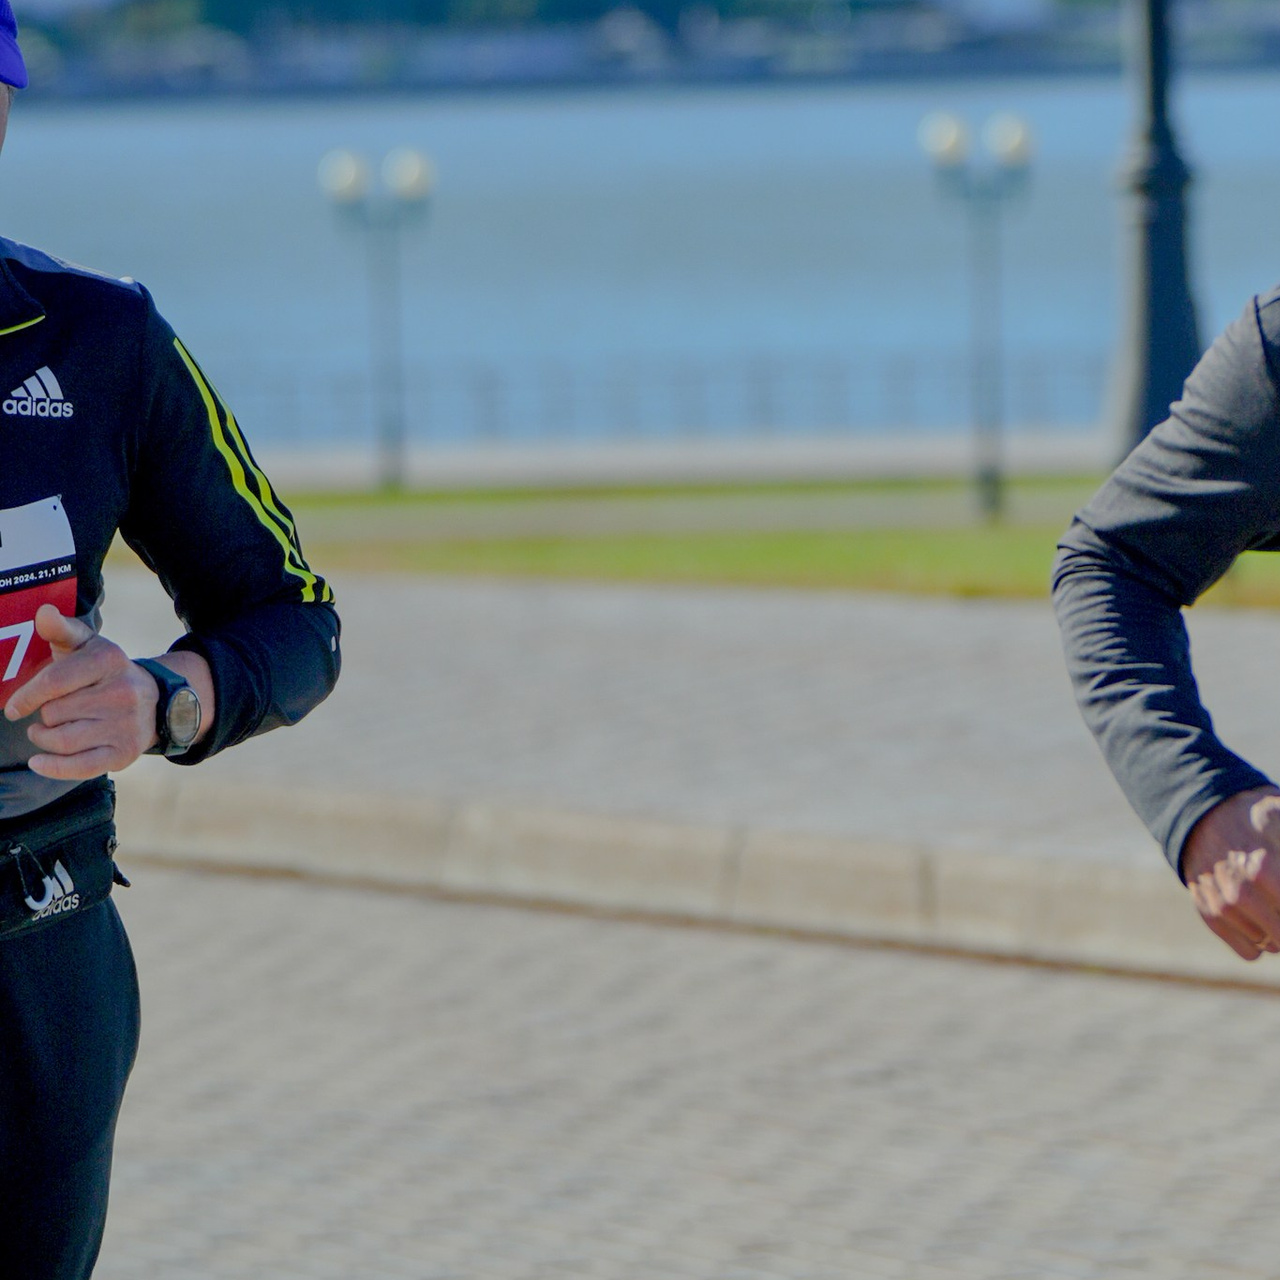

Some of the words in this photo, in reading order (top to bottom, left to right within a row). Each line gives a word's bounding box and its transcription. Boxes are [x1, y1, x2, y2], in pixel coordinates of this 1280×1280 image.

[2, 396, 74, 418] adidas
[13, 572, 37, 584] 2024.
[38, 567, 56, 577] 21,1
[0, 619, 35, 682] 7
